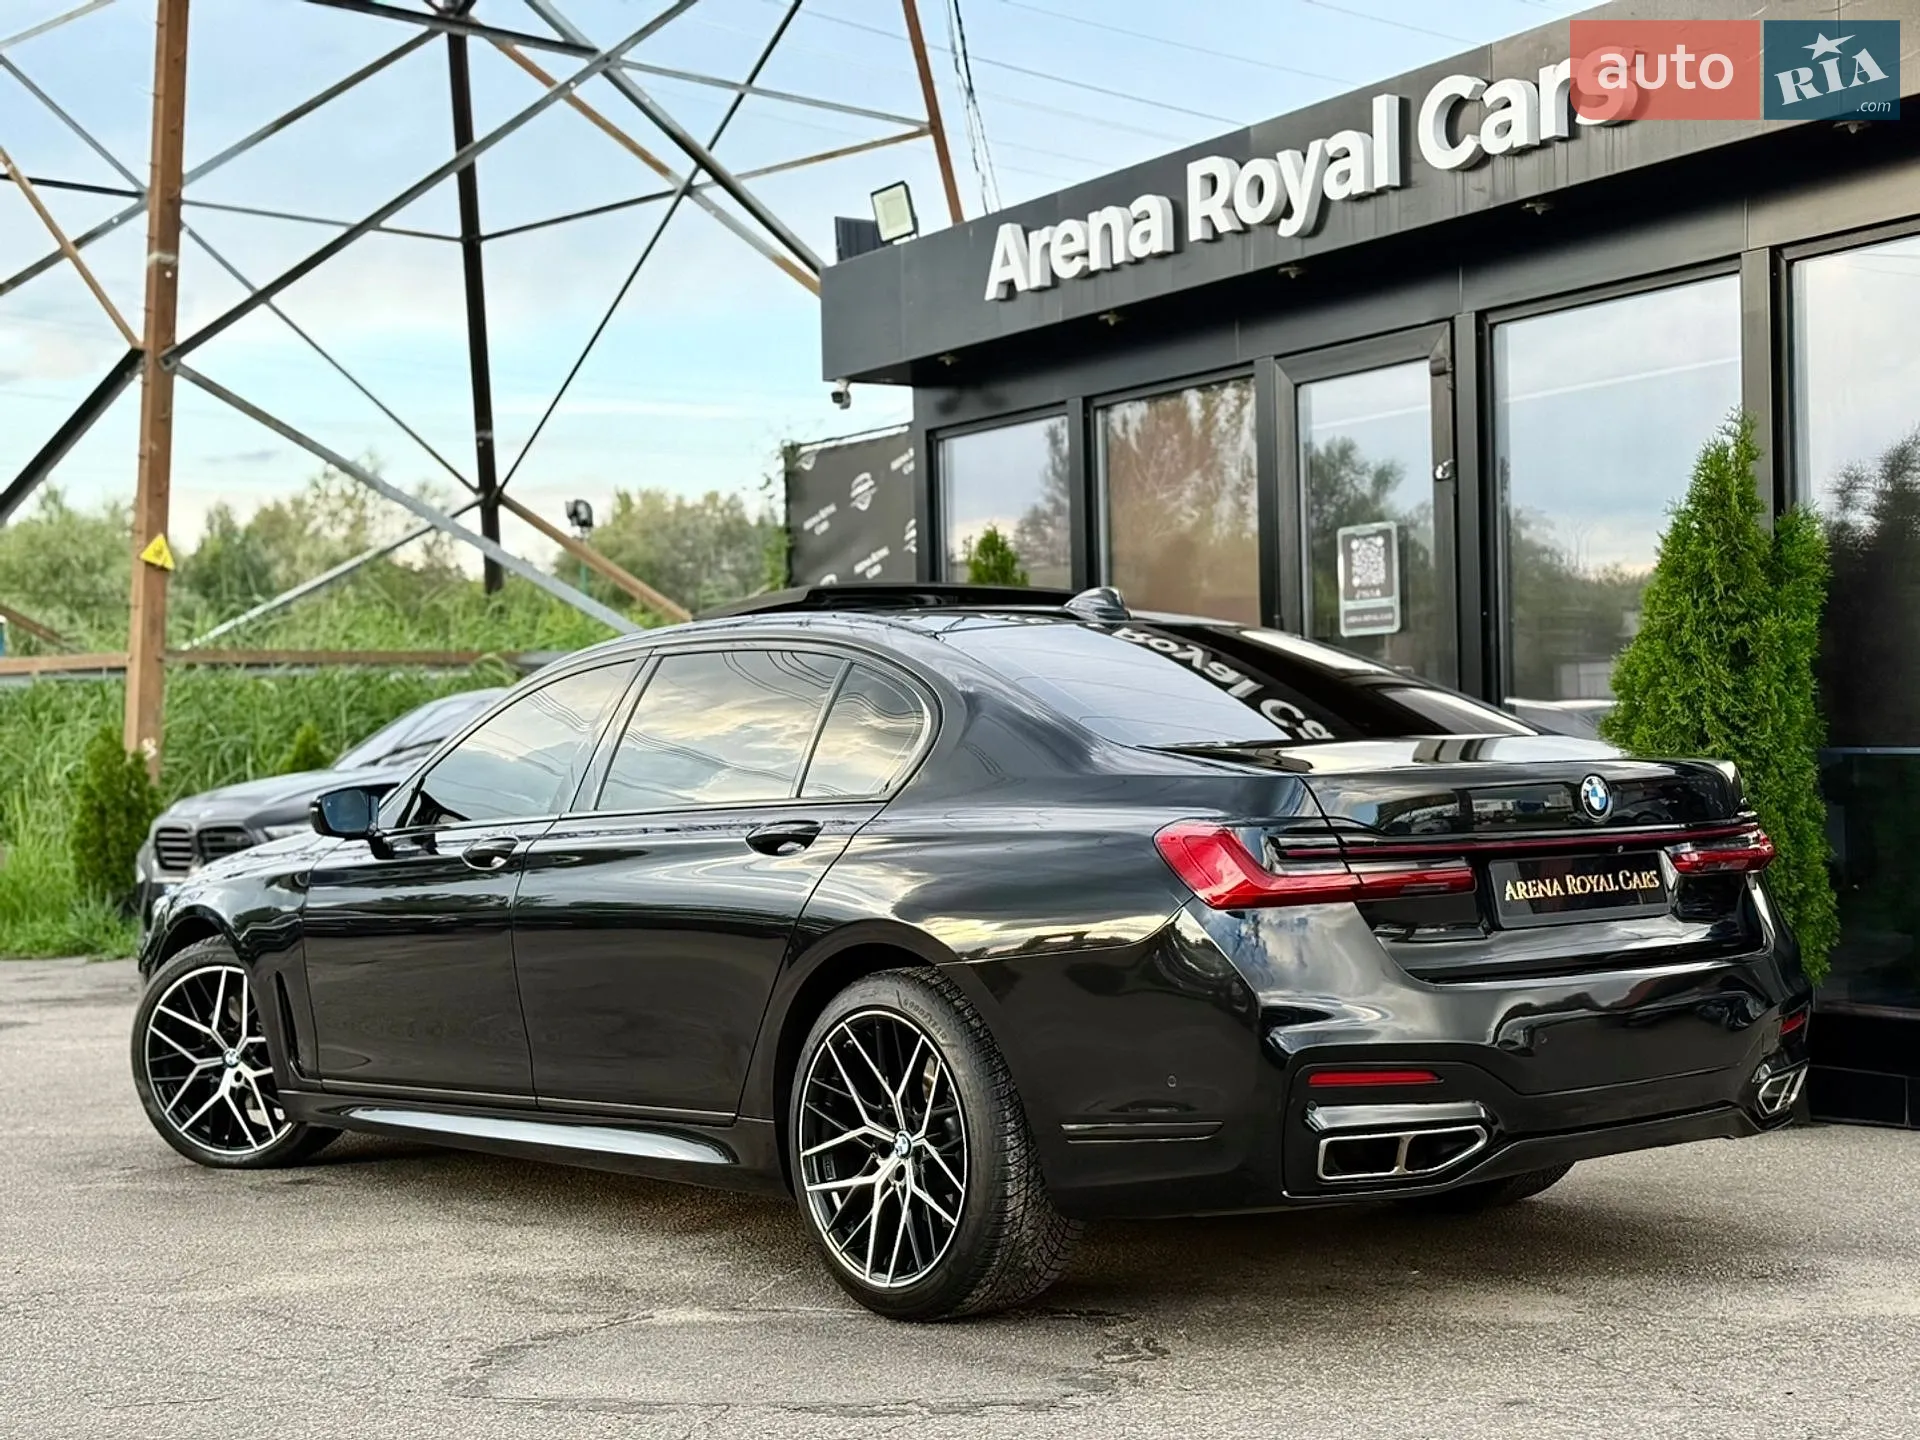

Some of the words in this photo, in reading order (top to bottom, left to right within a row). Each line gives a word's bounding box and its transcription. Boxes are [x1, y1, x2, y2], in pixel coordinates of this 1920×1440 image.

[984, 193, 1174, 301] Arena
[1187, 93, 1401, 242] Royal
[1418, 45, 1638, 170] Cars
[1505, 879, 1565, 901] ARENA
[1566, 873, 1619, 894] ROYAL
[1618, 869, 1660, 890] CARS
